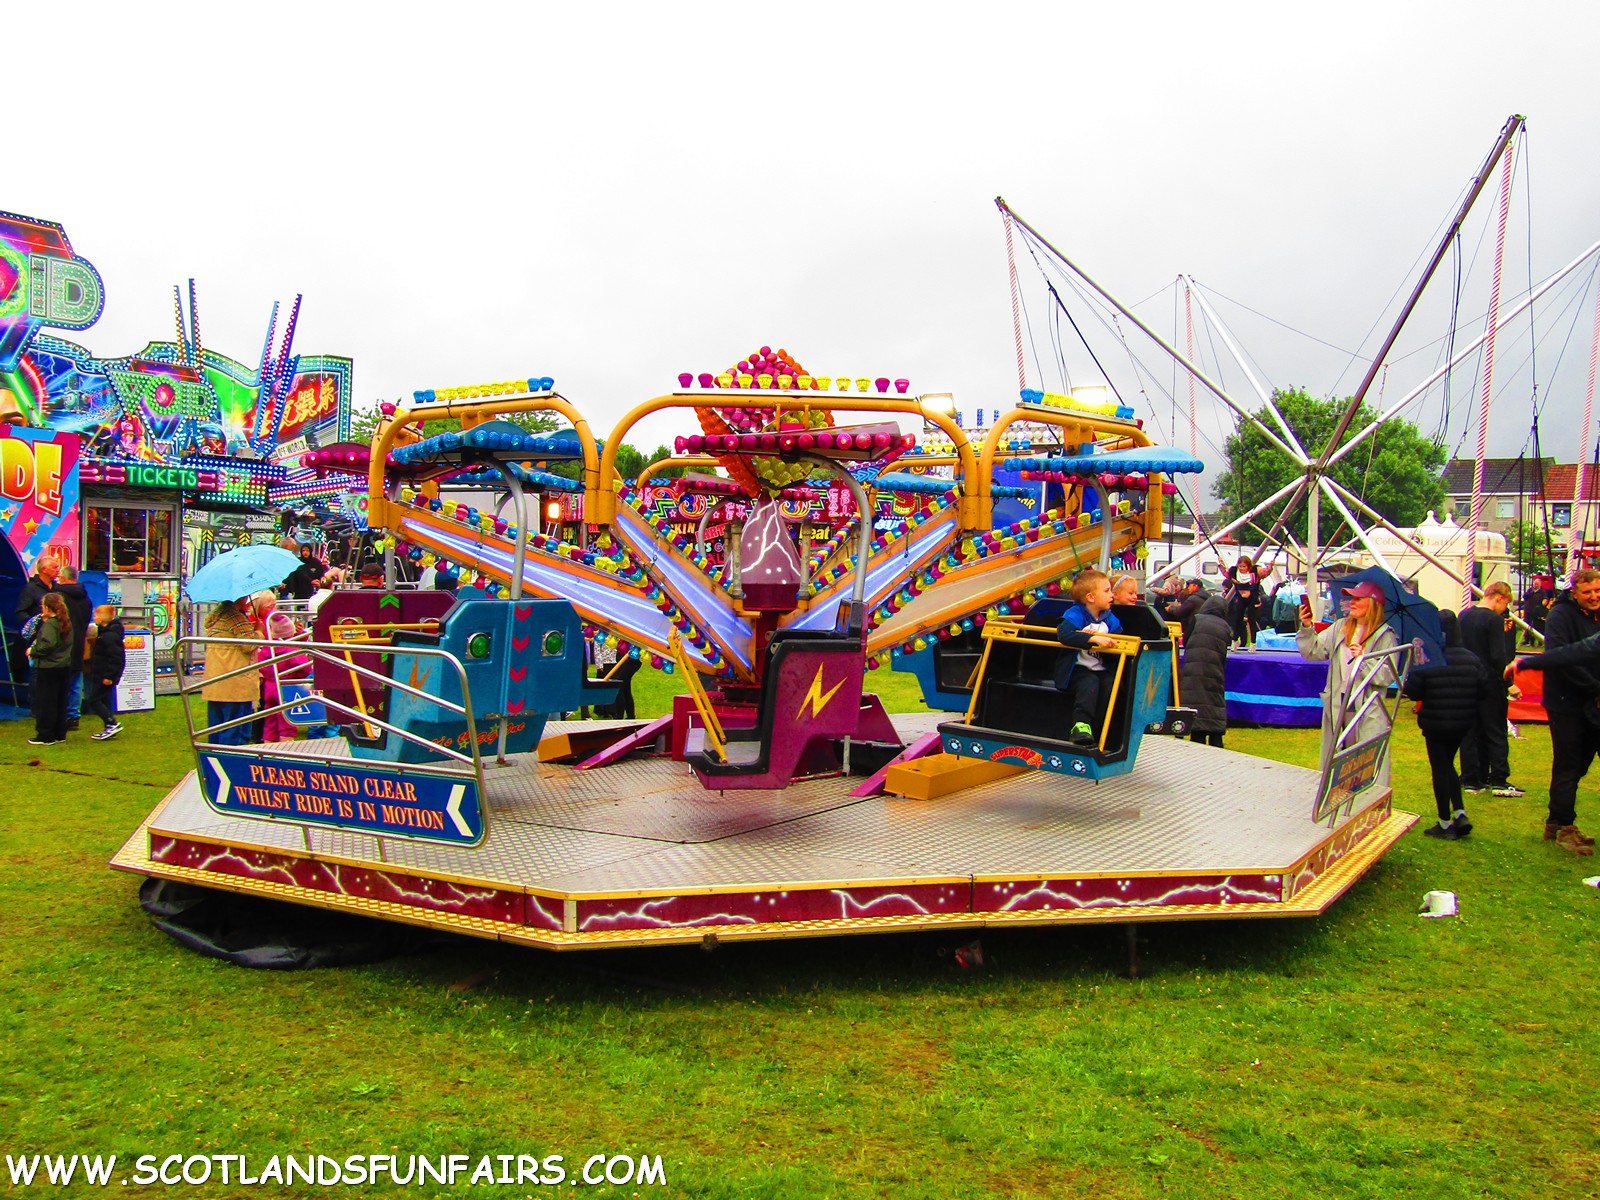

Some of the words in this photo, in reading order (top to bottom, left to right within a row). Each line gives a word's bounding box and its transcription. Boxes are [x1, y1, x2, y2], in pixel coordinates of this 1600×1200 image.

[109, 370, 214, 416] VOID
[126, 465, 197, 487] TICKETS
[249, 764, 306, 789] PLEASE
[309, 771, 360, 795] STAND
[363, 778, 418, 802] CLEAR
[234, 785, 291, 811] WHILST
[294, 793, 334, 817] RIDE
[335, 798, 354, 819] IS
[359, 801, 377, 822] IN
[382, 803, 445, 831] MOTION
